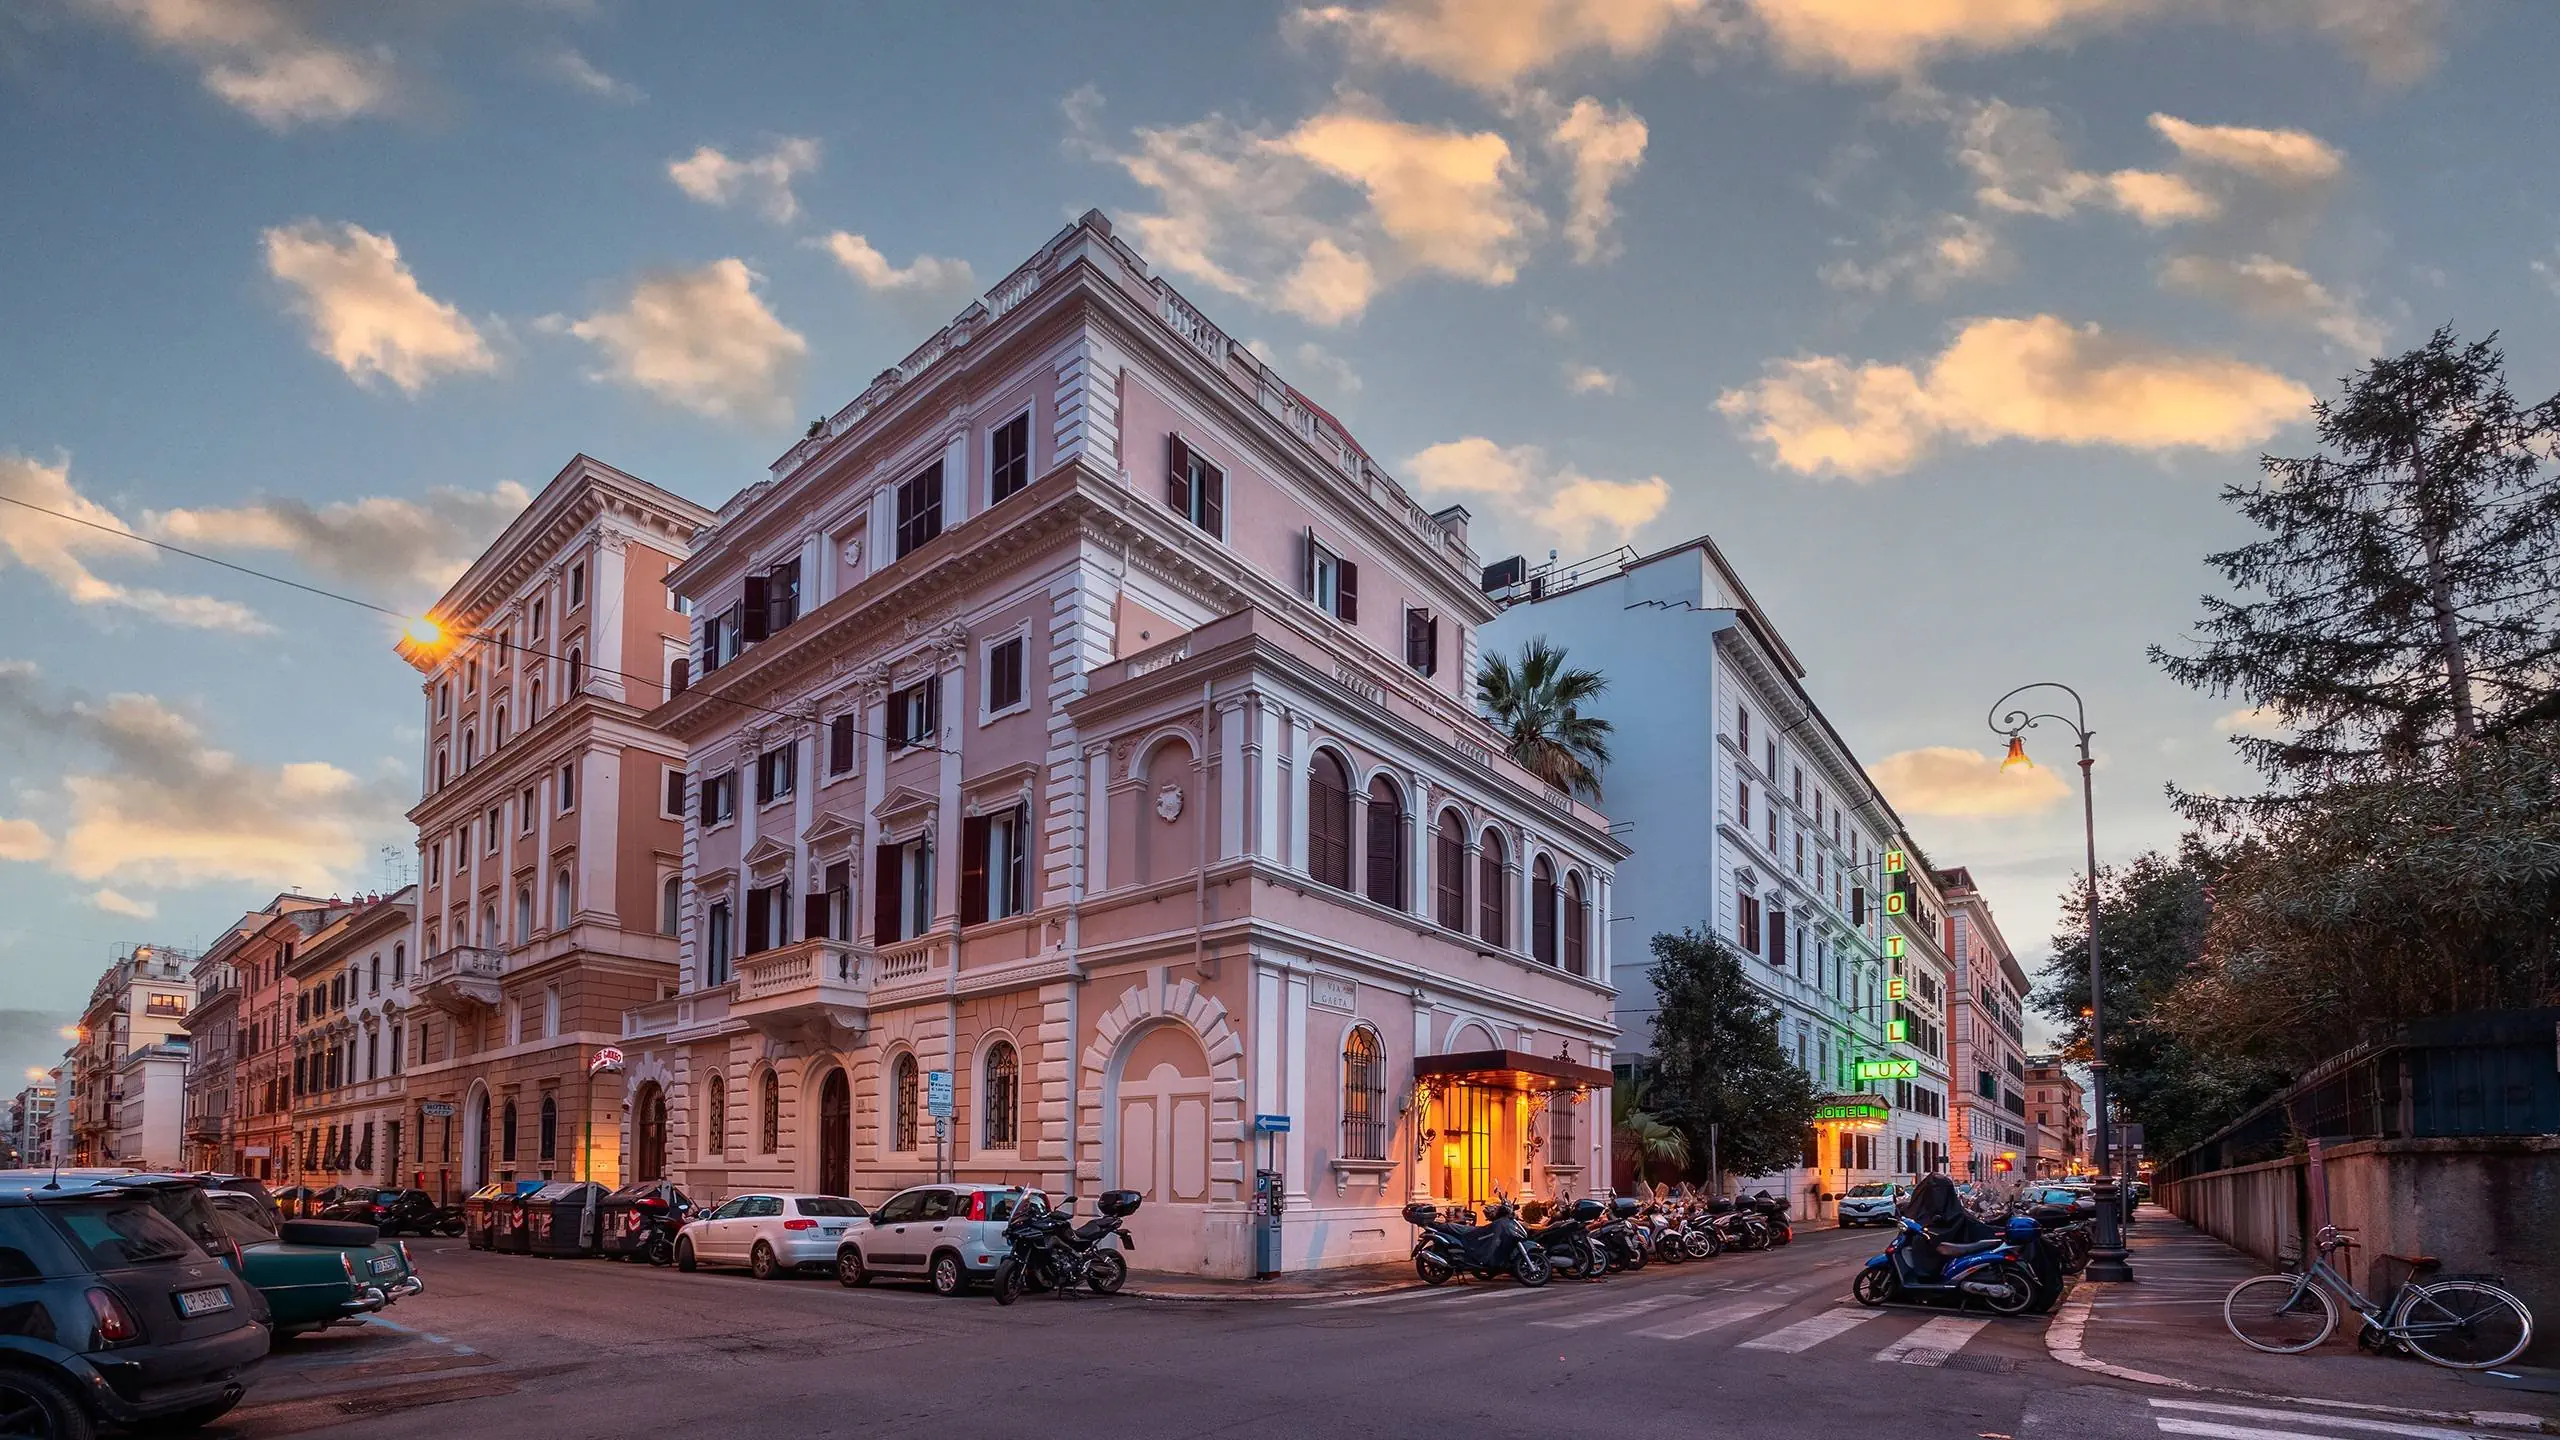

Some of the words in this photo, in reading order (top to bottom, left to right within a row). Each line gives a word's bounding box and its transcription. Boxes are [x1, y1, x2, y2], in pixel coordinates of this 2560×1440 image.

[1887, 853, 1902, 1041] HOTEL
[1327, 982, 1341, 993] VIA
[1321, 994, 1347, 1008] GAETA
[1864, 1062, 1911, 1078] LUX
[426, 1103, 452, 1111] HOTEL
[1815, 1106, 1867, 1118] HOTEL
[184, 1292, 197, 1311] CP
